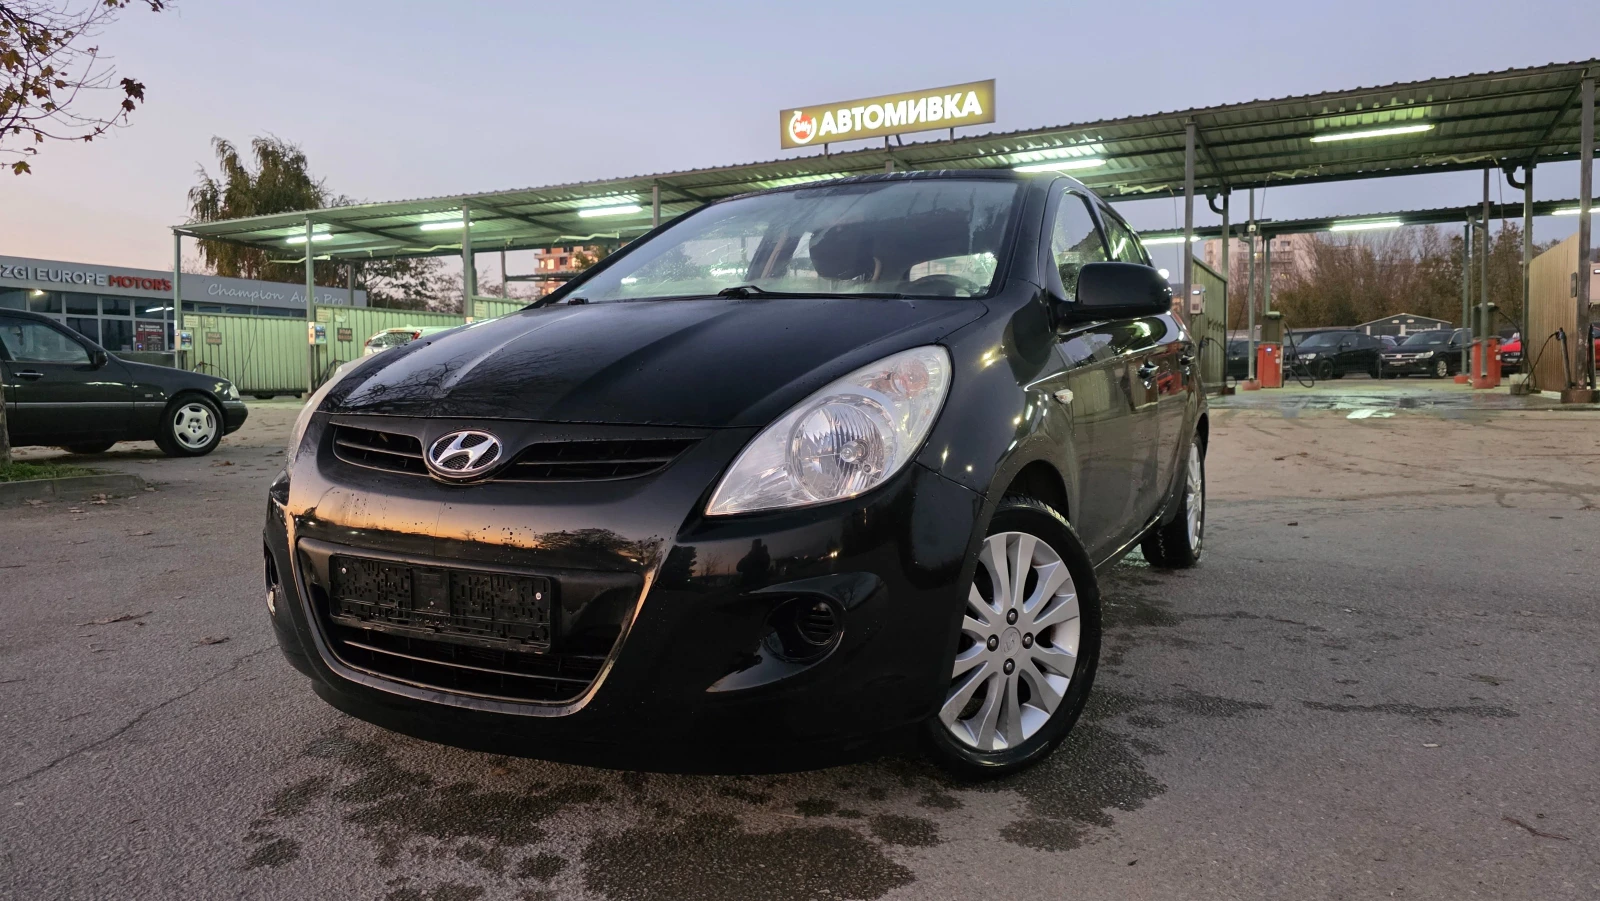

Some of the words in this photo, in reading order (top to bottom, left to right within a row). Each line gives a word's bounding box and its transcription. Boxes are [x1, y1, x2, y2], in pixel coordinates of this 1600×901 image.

[819, 91, 982, 136] АВТОМИВКА
[0, 264, 32, 280] ZGI
[35, 267, 107, 286] EUROPE
[109, 274, 173, 292] MOTOR'S
[207, 283, 285, 302] Champion
[290, 291, 319, 305] Auo
[323, 294, 343, 306] Pro
